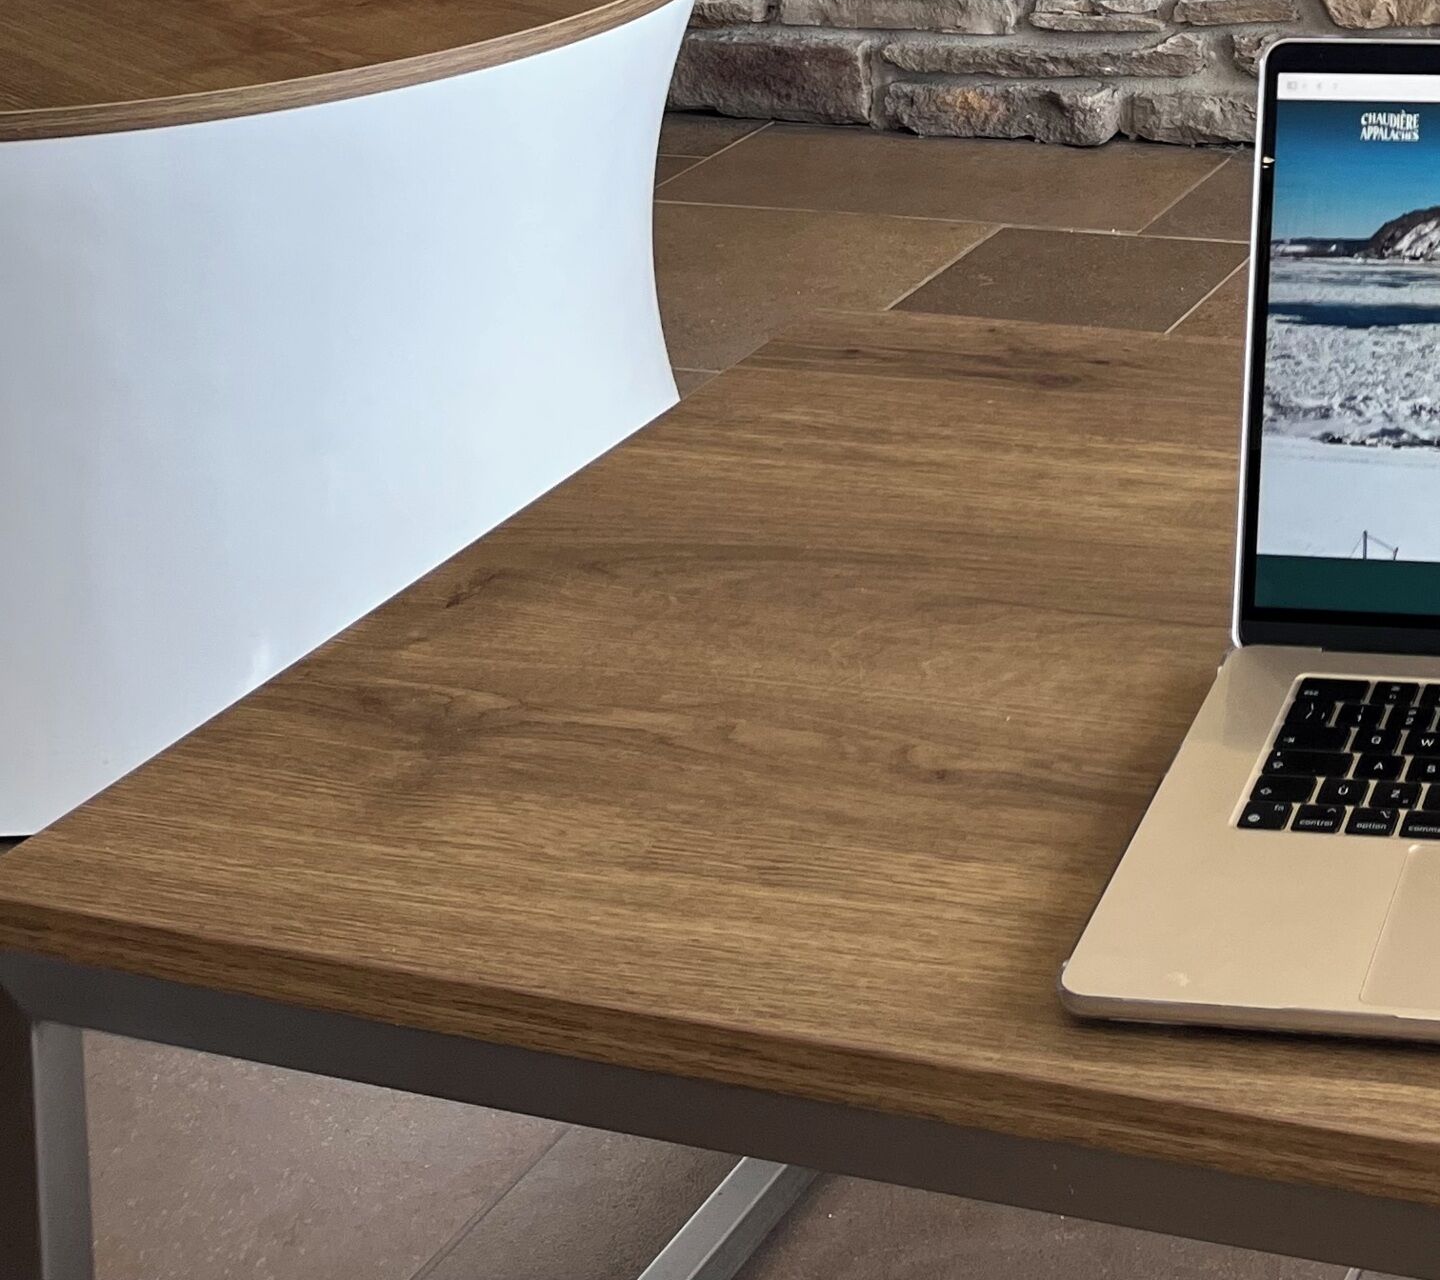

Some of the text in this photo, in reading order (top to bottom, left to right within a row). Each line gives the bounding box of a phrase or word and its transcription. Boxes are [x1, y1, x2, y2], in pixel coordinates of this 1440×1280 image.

[1361, 109, 1420, 130] CHAUDIÈRE
[1421, 738, 1435, 747] W
[1373, 761, 1384, 770] A
[1299, 819, 1333, 827] control
[1356, 821, 1387, 831] option
